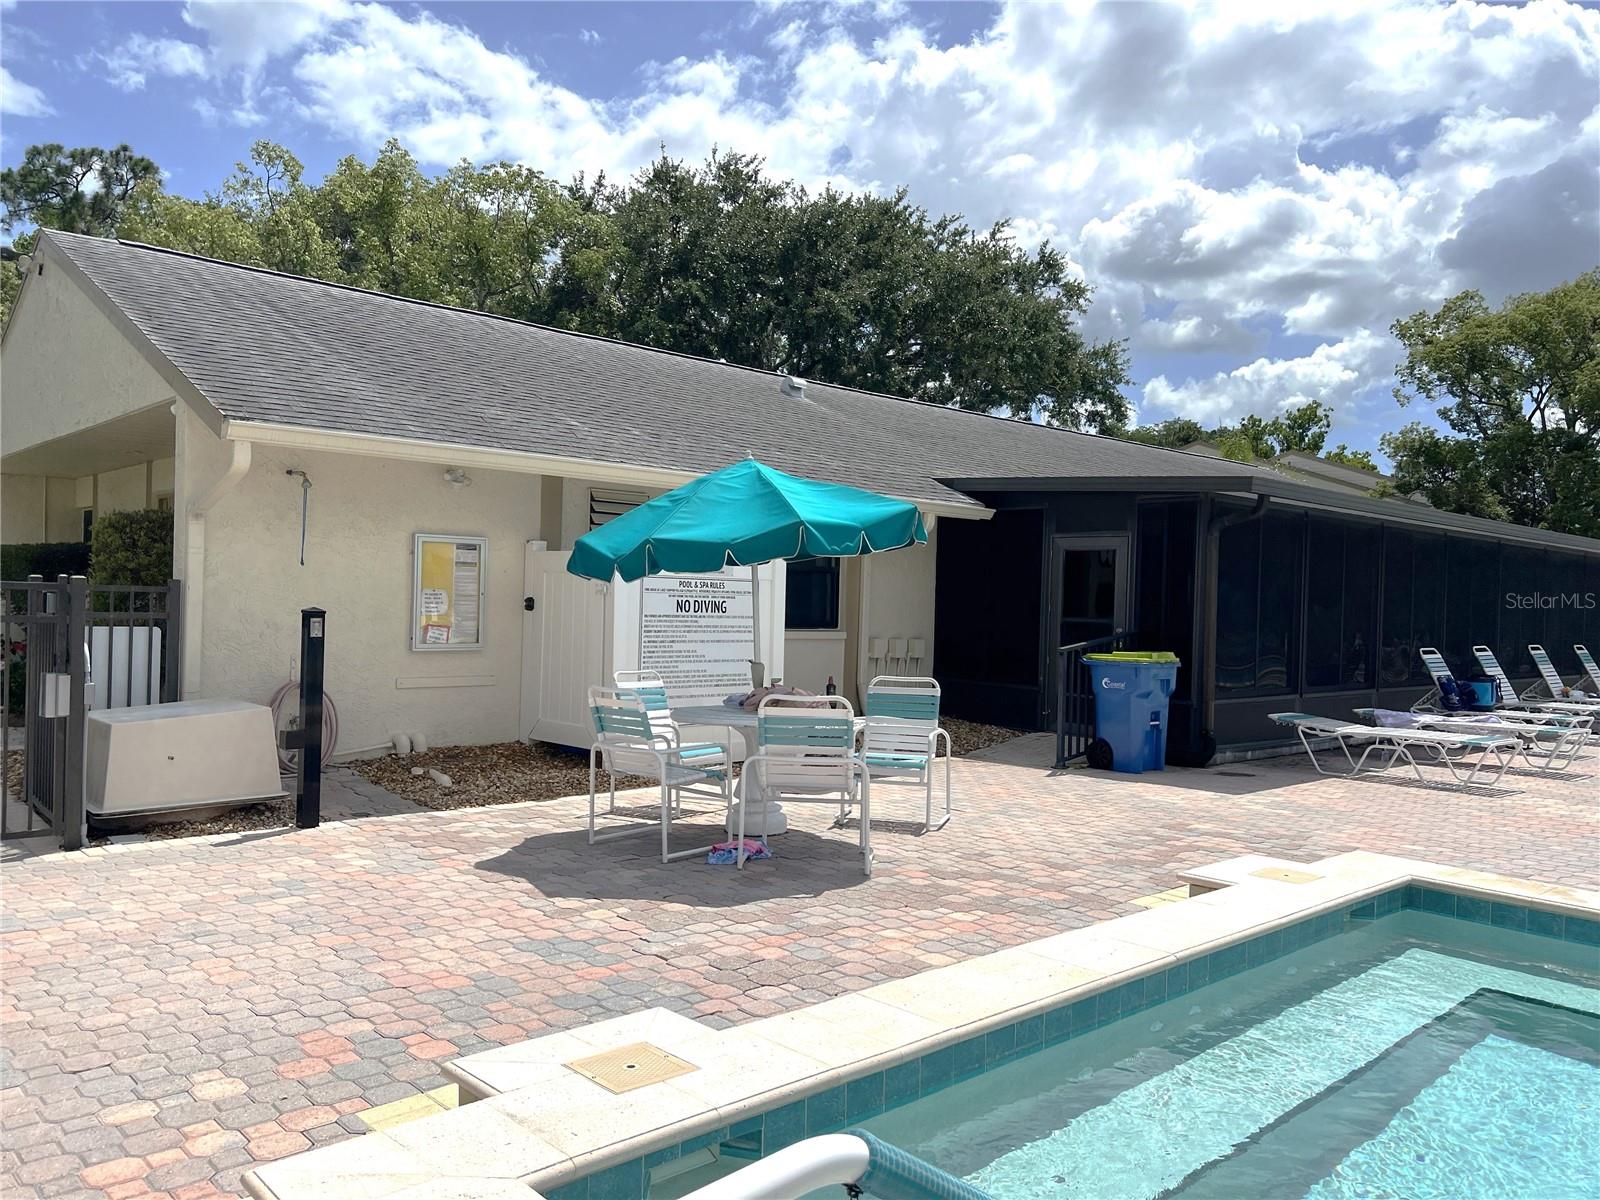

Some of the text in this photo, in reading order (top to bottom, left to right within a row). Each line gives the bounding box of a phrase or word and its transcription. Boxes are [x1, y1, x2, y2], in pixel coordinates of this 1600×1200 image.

[679, 580, 726, 589] POOL & SPA RULES
[676, 599, 727, 613] NO DIVING
